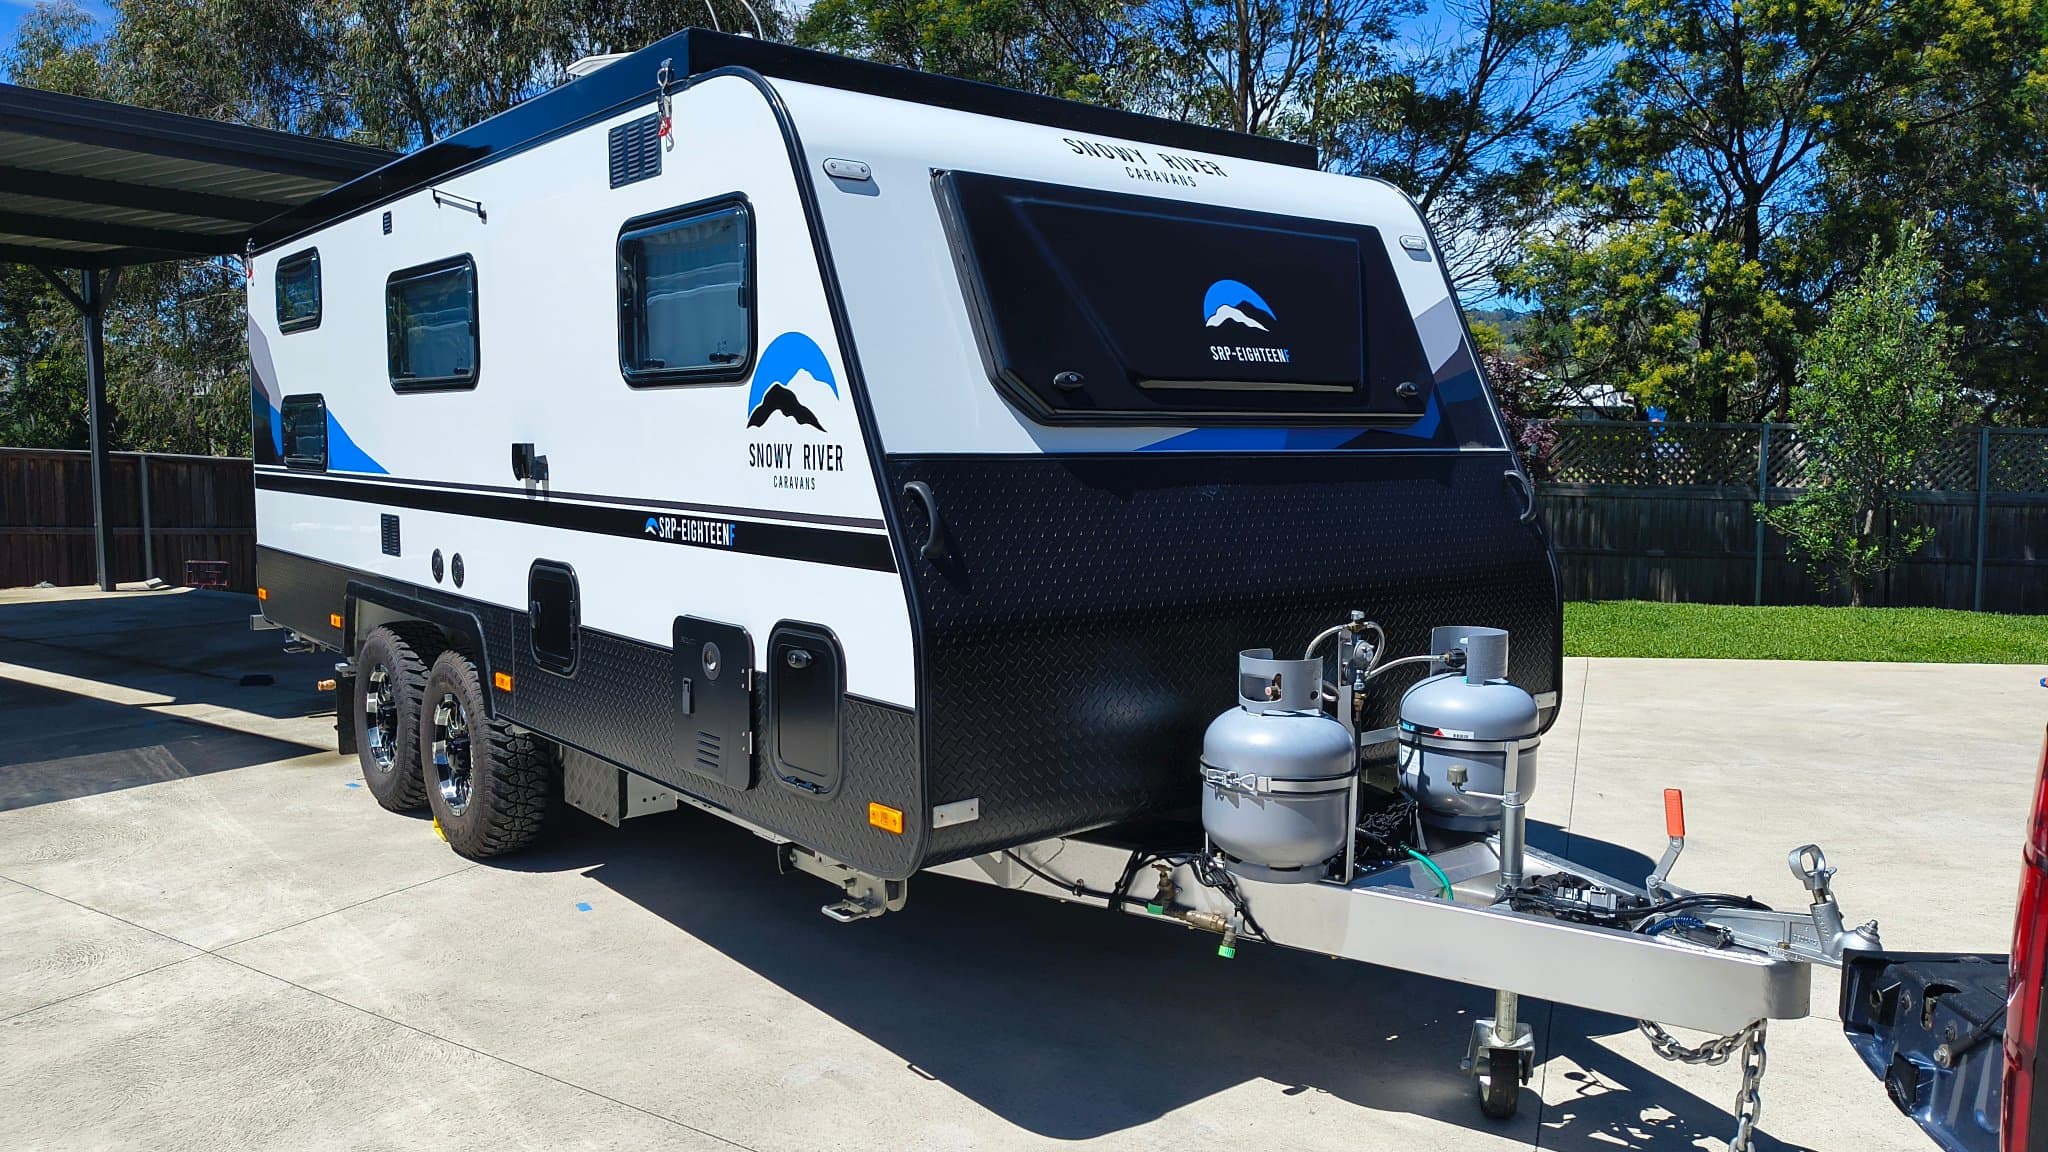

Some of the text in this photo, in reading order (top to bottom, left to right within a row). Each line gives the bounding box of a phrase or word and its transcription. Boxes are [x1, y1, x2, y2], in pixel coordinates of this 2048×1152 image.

[1063, 137, 1228, 178] SNOWY RIVER
[1125, 166, 1197, 188] CARAVANS
[1210, 345, 1290, 363] SRP-EIGHTEENF
[749, 443, 844, 472] SNOWY RIVER
[773, 475, 816, 491] CARAVANS
[658, 516, 736, 547] SRP-EIGHTEENF
